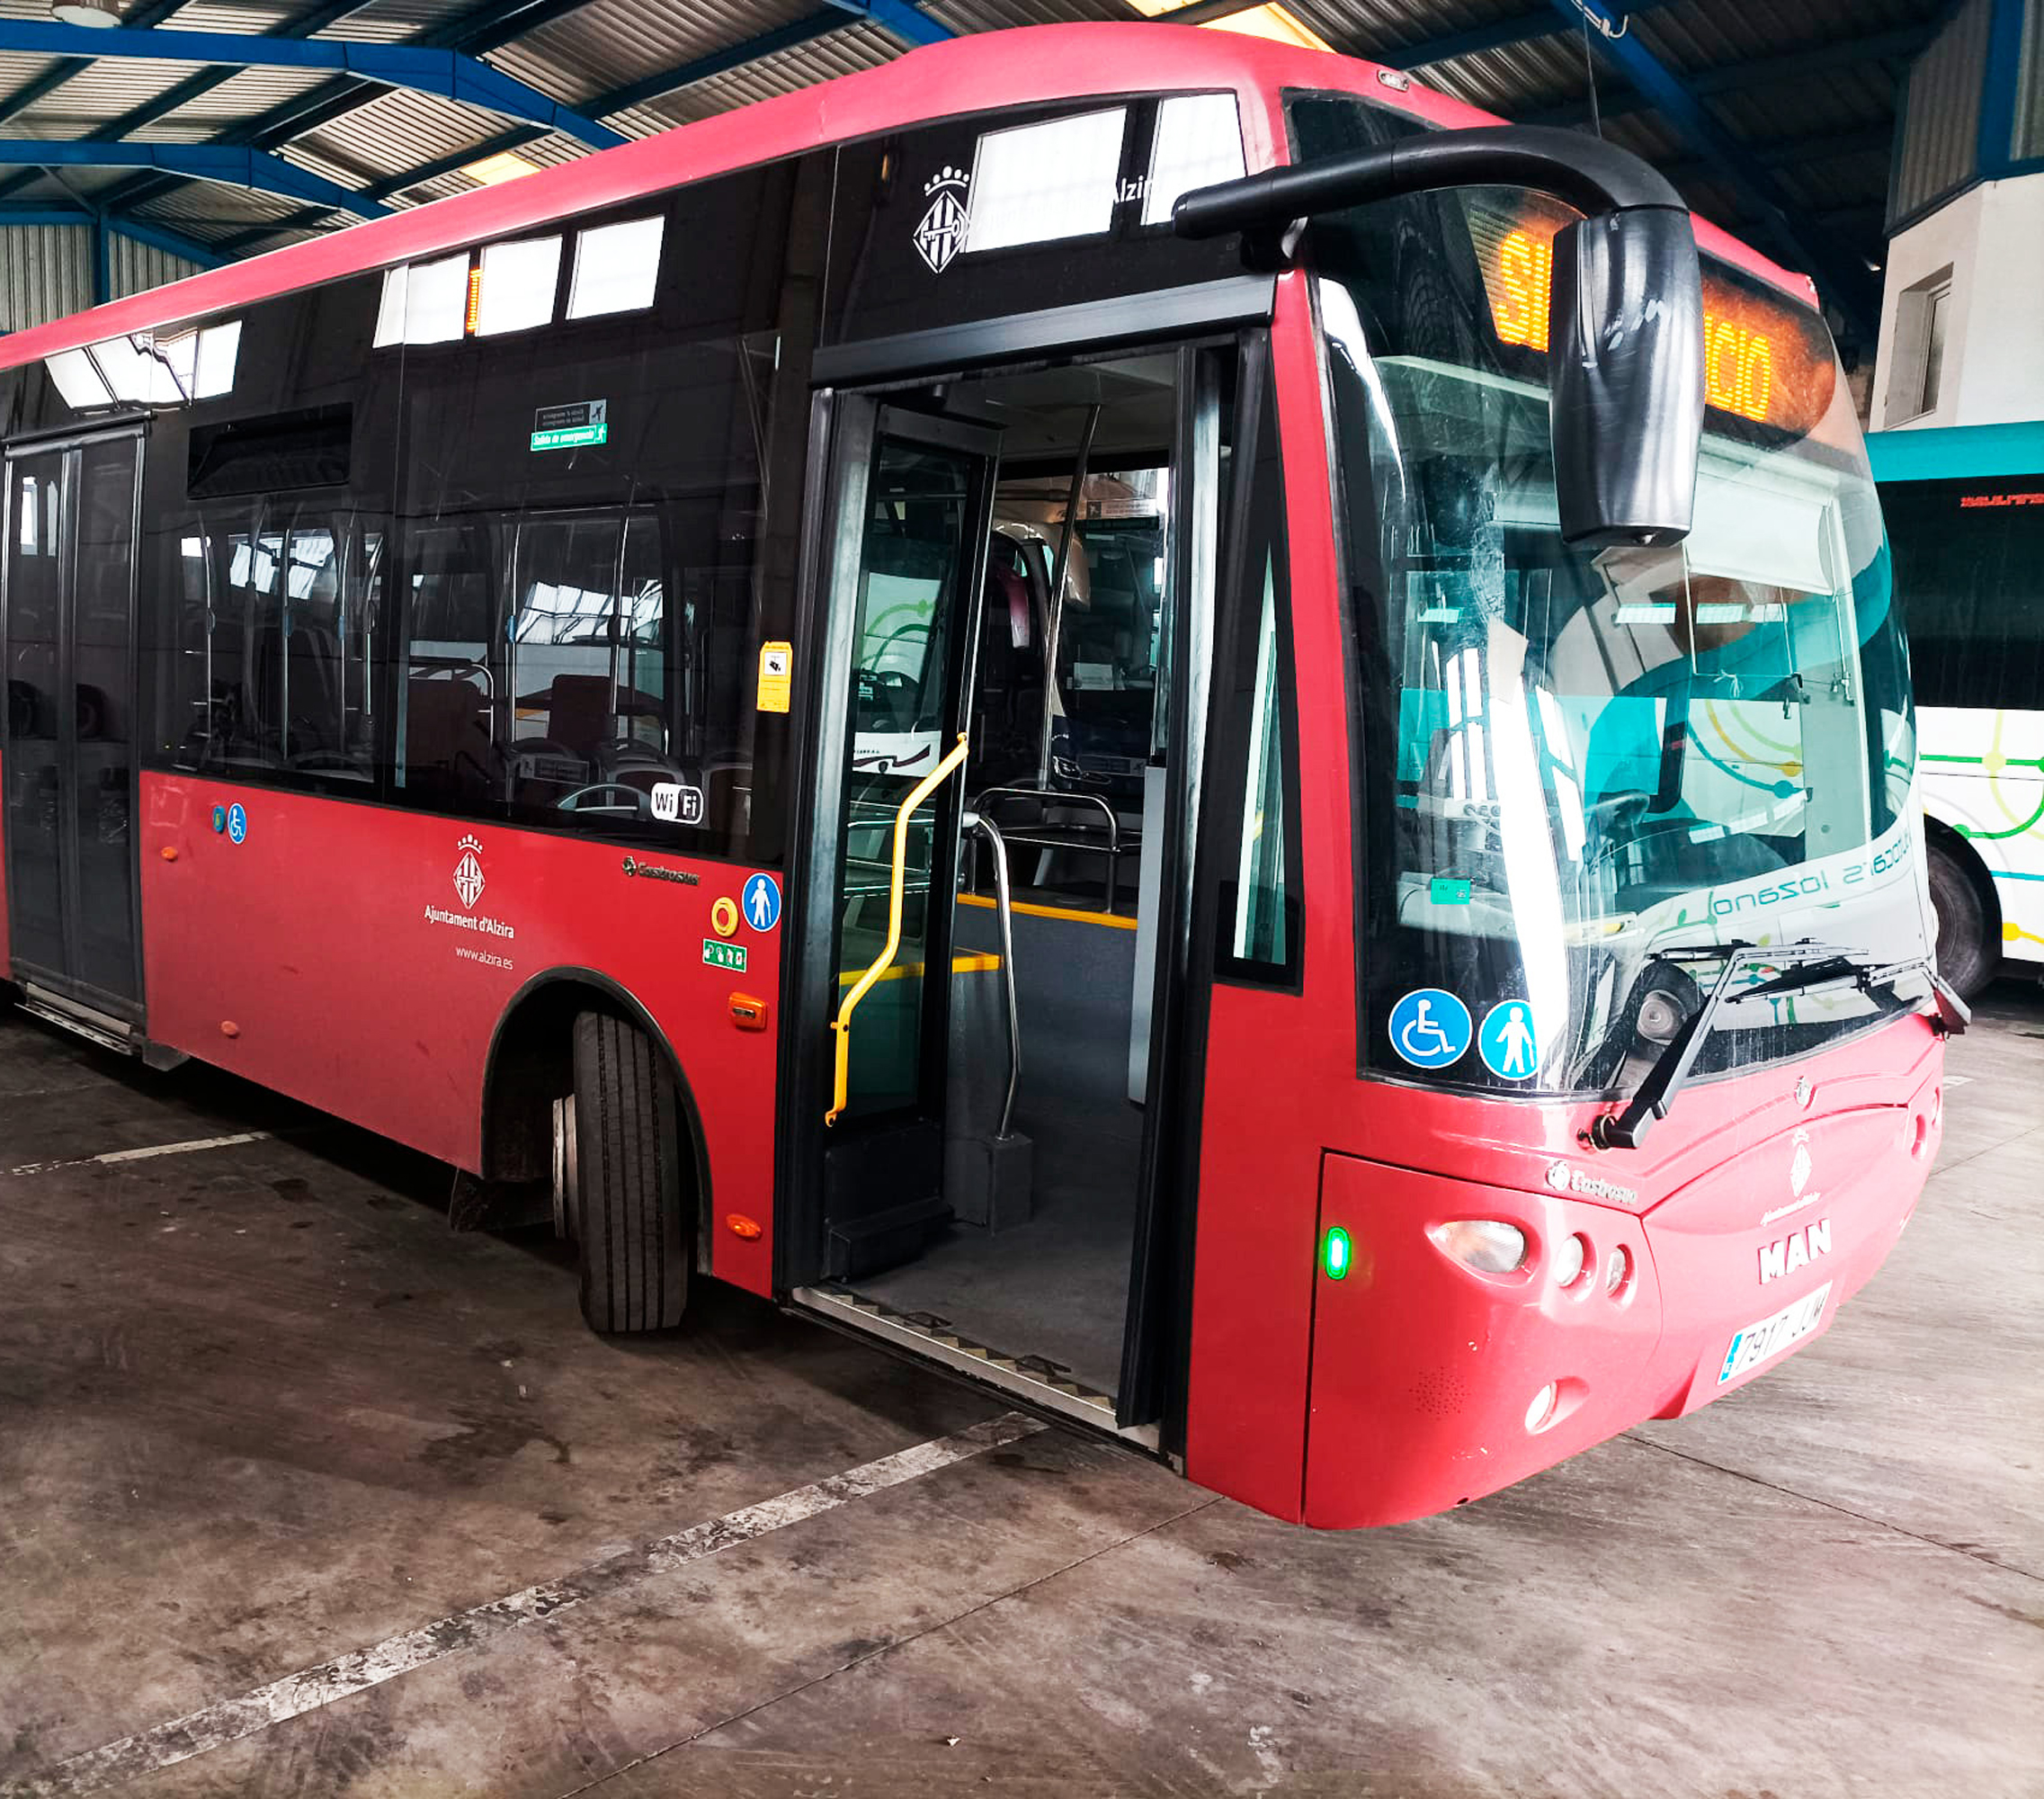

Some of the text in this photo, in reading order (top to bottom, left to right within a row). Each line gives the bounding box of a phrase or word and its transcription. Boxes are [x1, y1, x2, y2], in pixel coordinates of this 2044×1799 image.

[424, 904, 514, 939] Ajuntament d'Alzira
[455, 946, 513, 971] www.alzira.es
[1757, 1217, 1832, 1285] MAN
[1735, 1314, 1789, 1370] 7917
